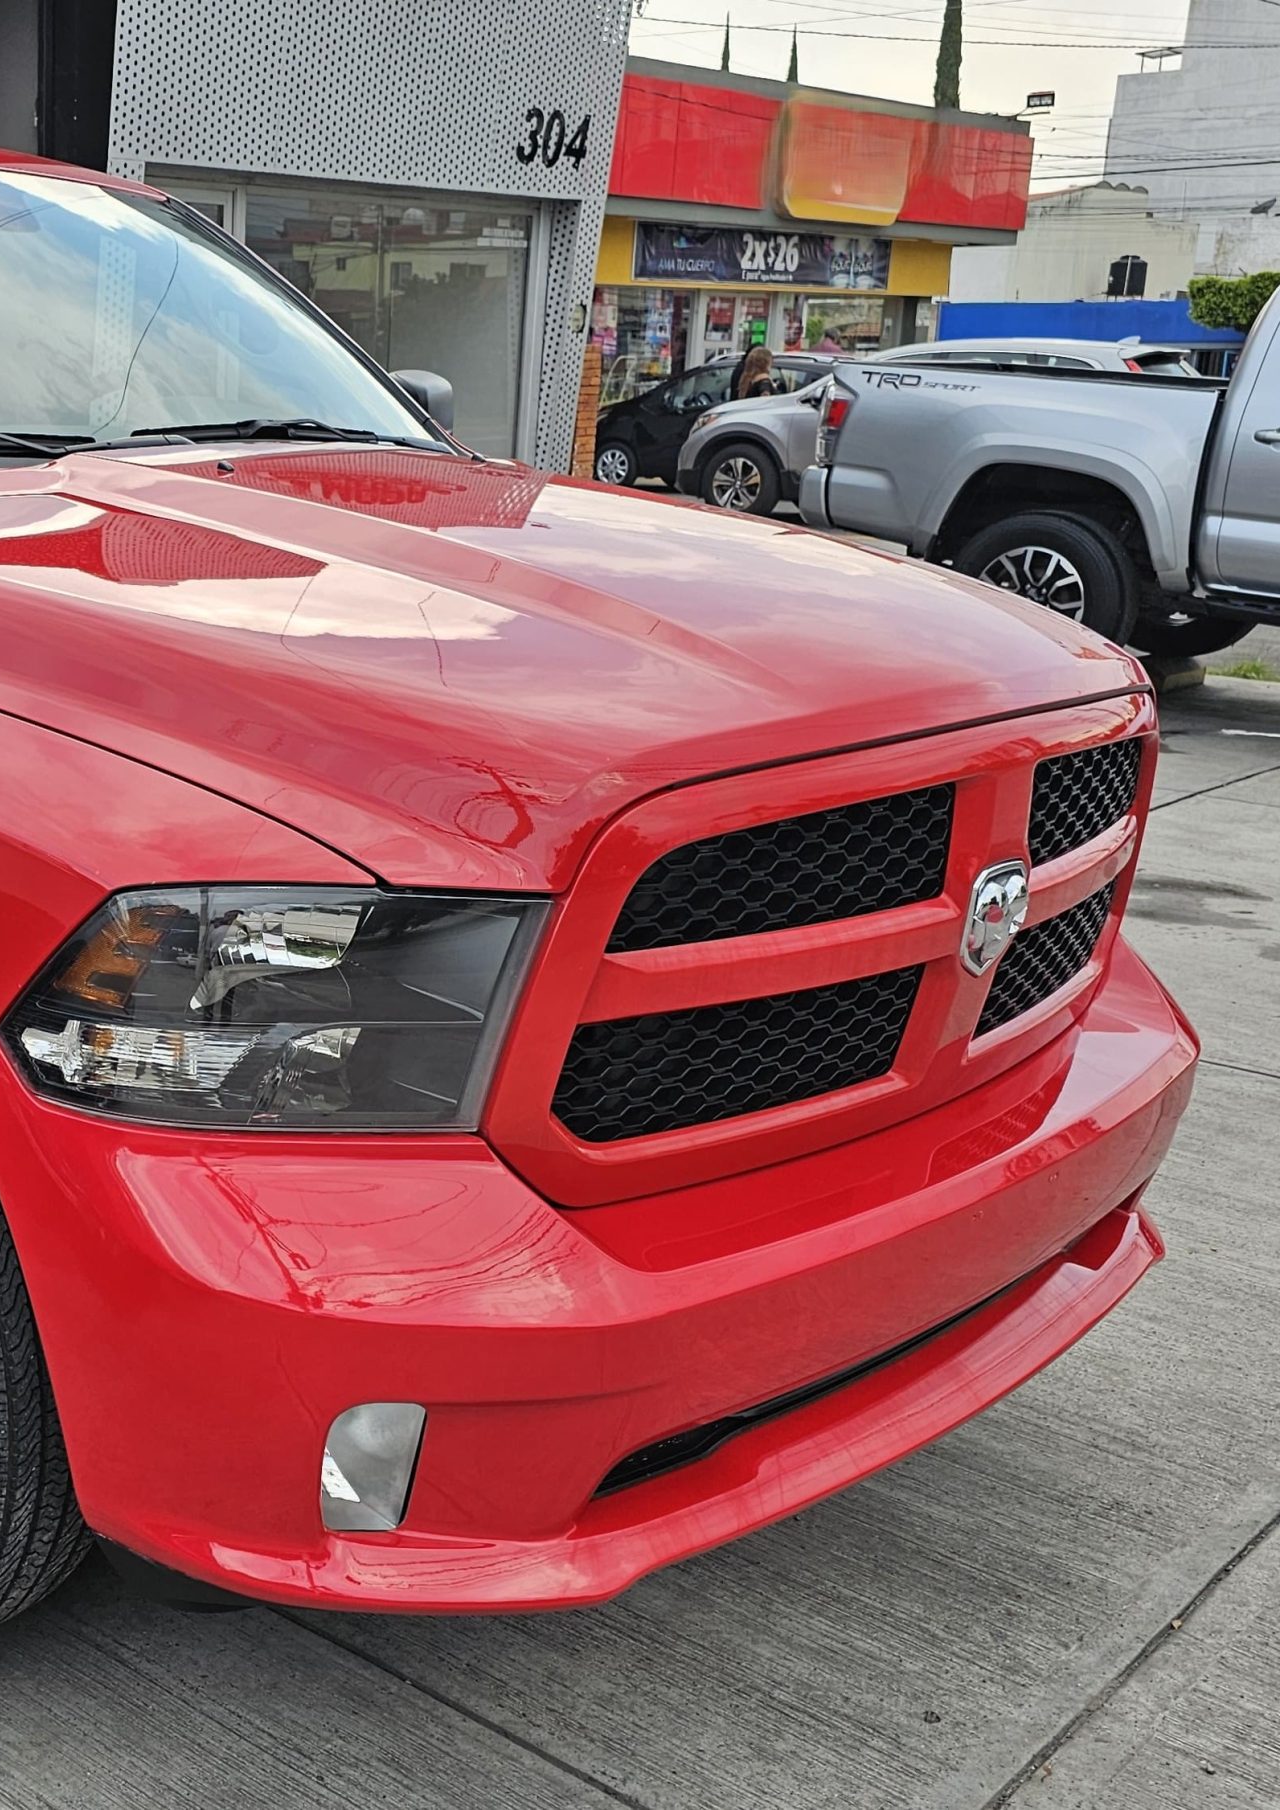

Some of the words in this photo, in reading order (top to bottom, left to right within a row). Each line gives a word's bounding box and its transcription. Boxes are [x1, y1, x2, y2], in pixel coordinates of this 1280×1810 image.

[516, 106, 591, 171] 304
[862, 370, 922, 390] TRD
[923, 381, 982, 392] SPORT
